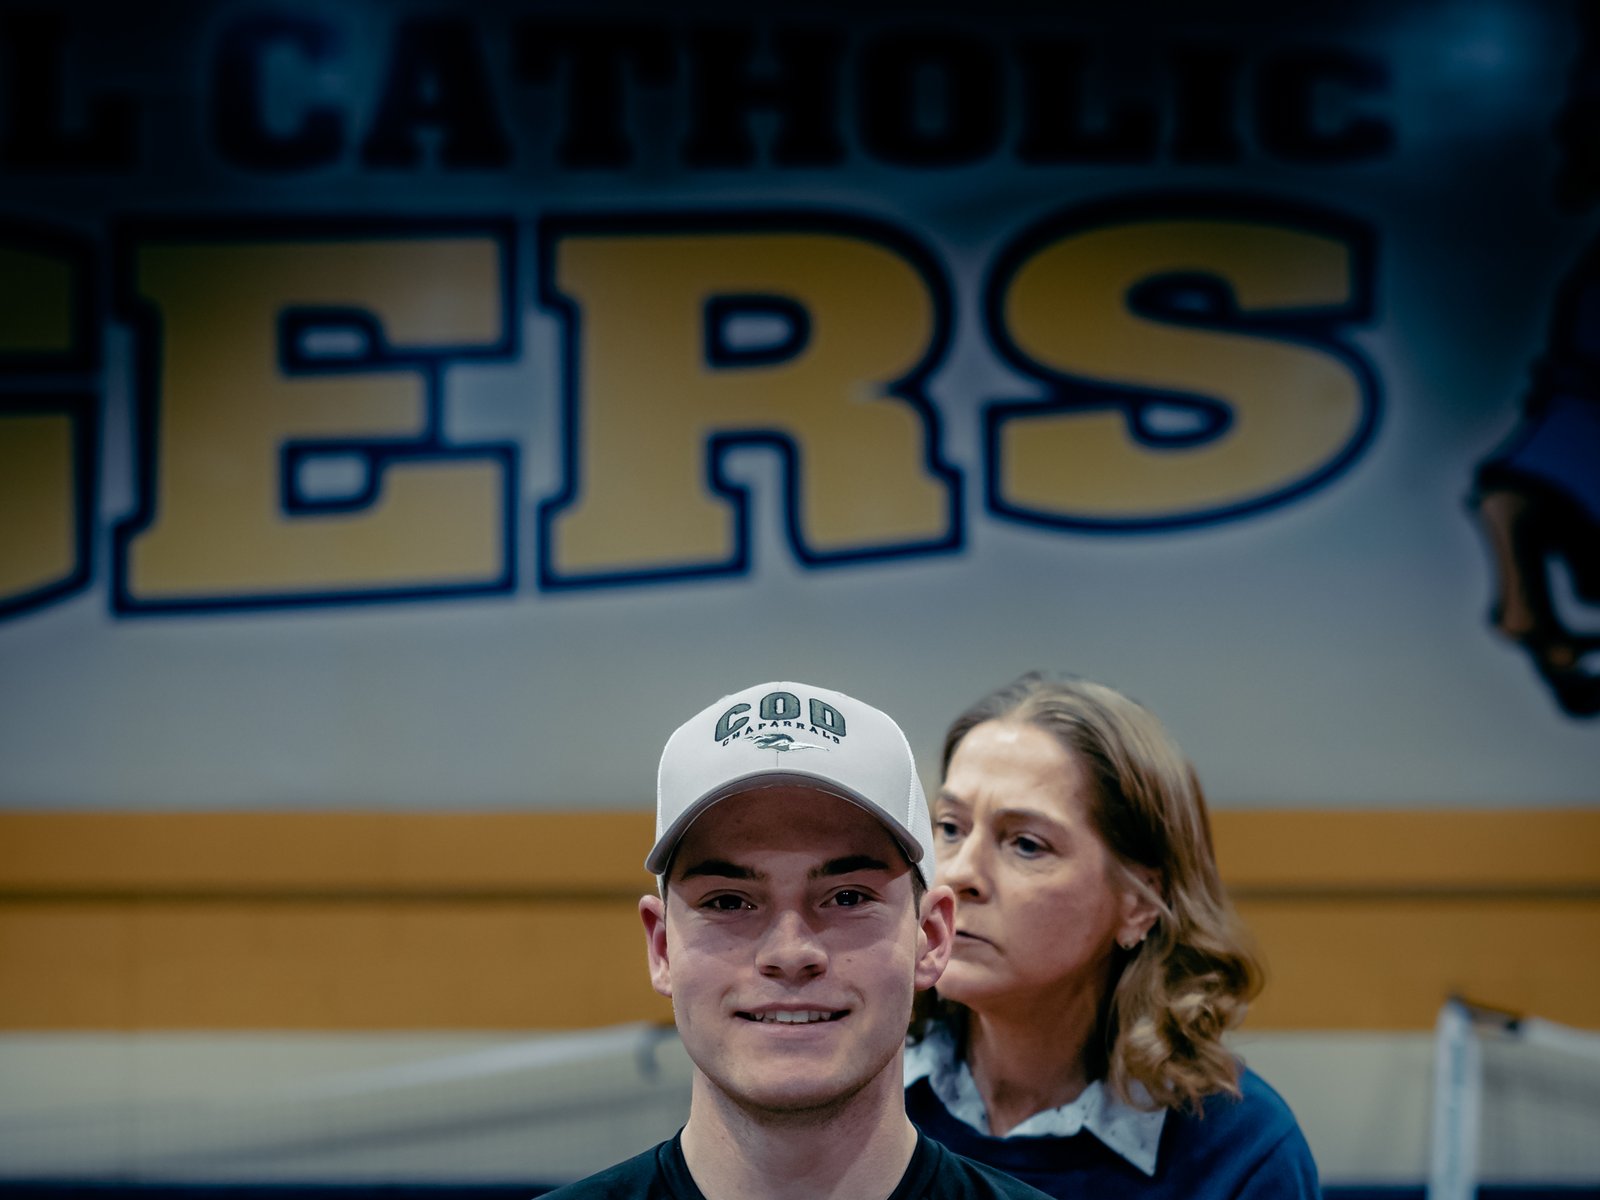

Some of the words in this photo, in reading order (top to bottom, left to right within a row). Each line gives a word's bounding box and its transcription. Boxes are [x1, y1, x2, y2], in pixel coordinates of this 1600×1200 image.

[210, 12, 1396, 170] CATHOLIC
[715, 691, 847, 742] COD
[722, 721, 841, 747] CHAPARRALS
